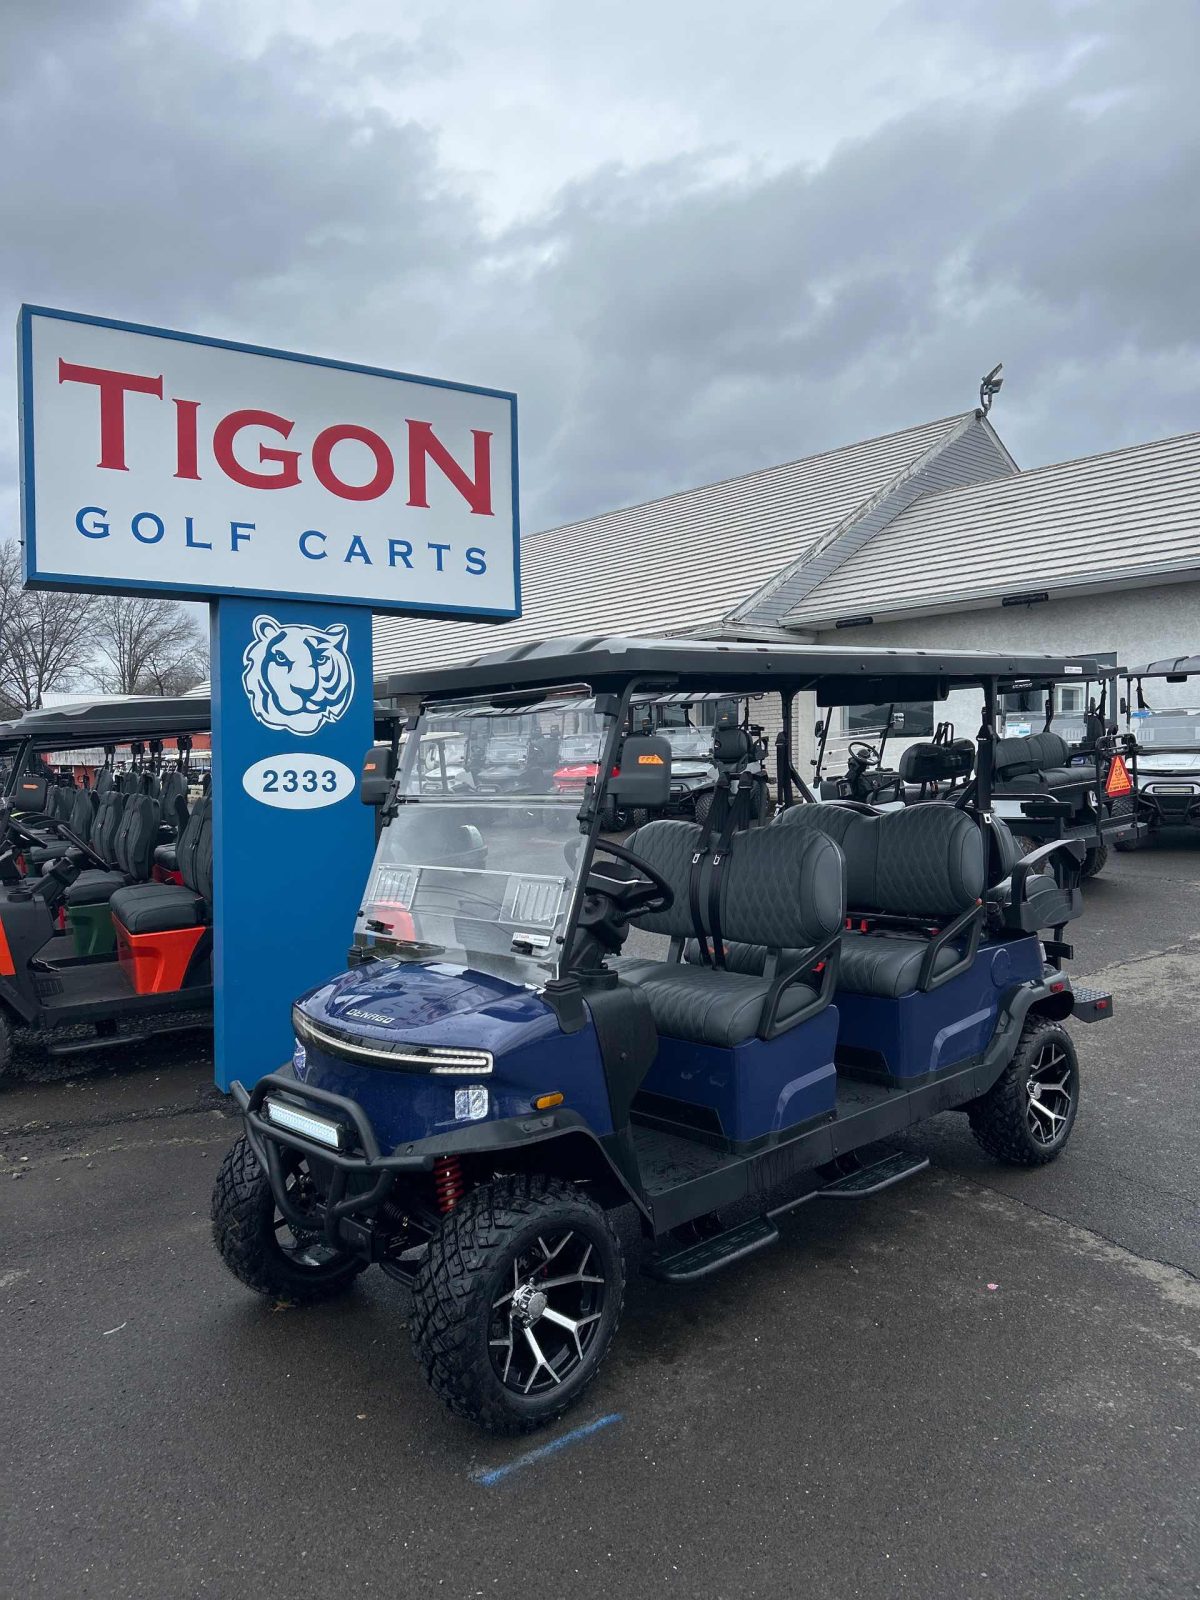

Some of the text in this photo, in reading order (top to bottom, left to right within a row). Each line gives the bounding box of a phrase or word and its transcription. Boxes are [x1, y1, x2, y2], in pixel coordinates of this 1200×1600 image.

[59, 357, 494, 515] TIGON
[75, 506, 487, 576] GOLF CARTS
[262, 769, 338, 793] 2333
[345, 1008, 396, 1024] DENAGO
